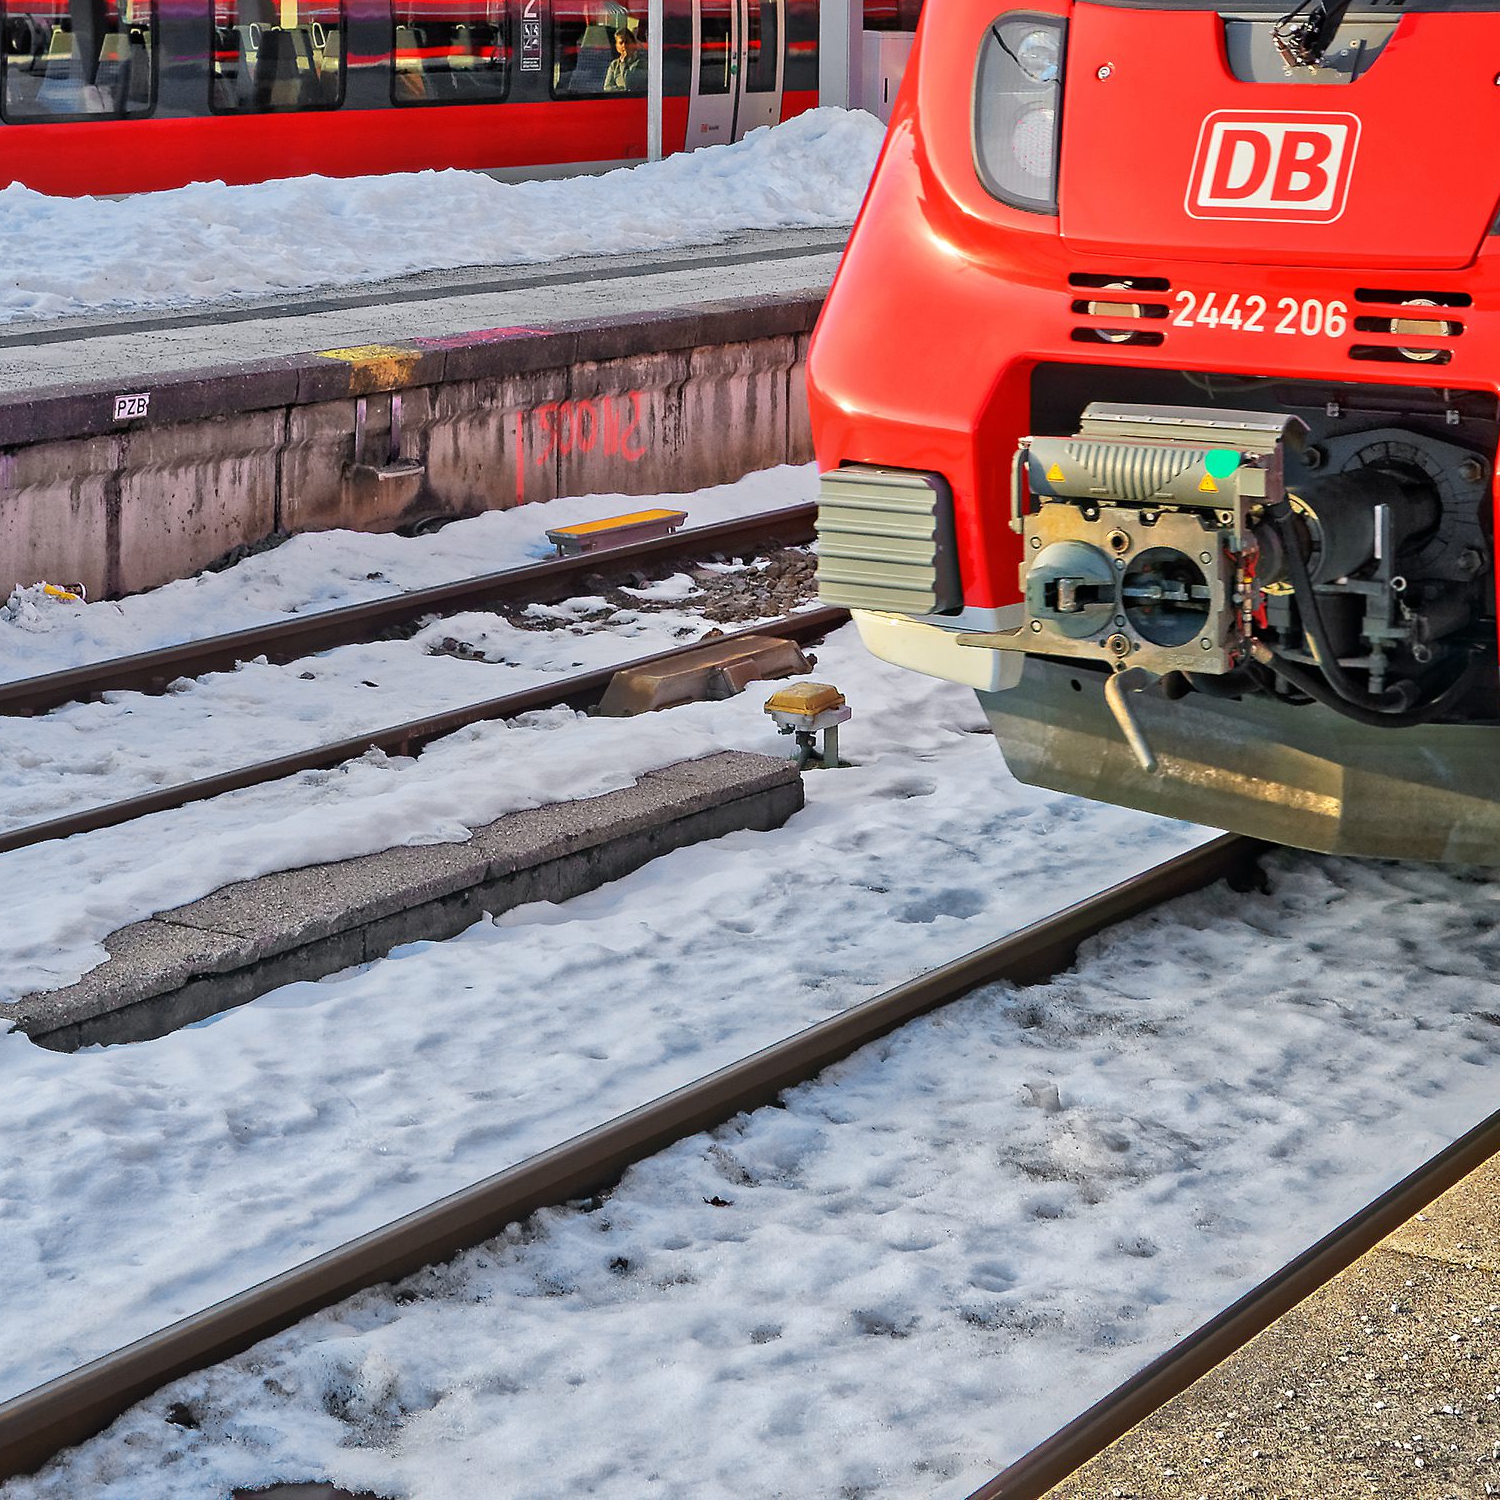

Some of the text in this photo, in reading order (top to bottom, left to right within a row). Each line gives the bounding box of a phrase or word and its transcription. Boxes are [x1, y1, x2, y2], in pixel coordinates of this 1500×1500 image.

[1209, 129, 1333, 203] DB
[1172, 290, 1348, 338] 2442 206
[117, 398, 146, 417] PZB
